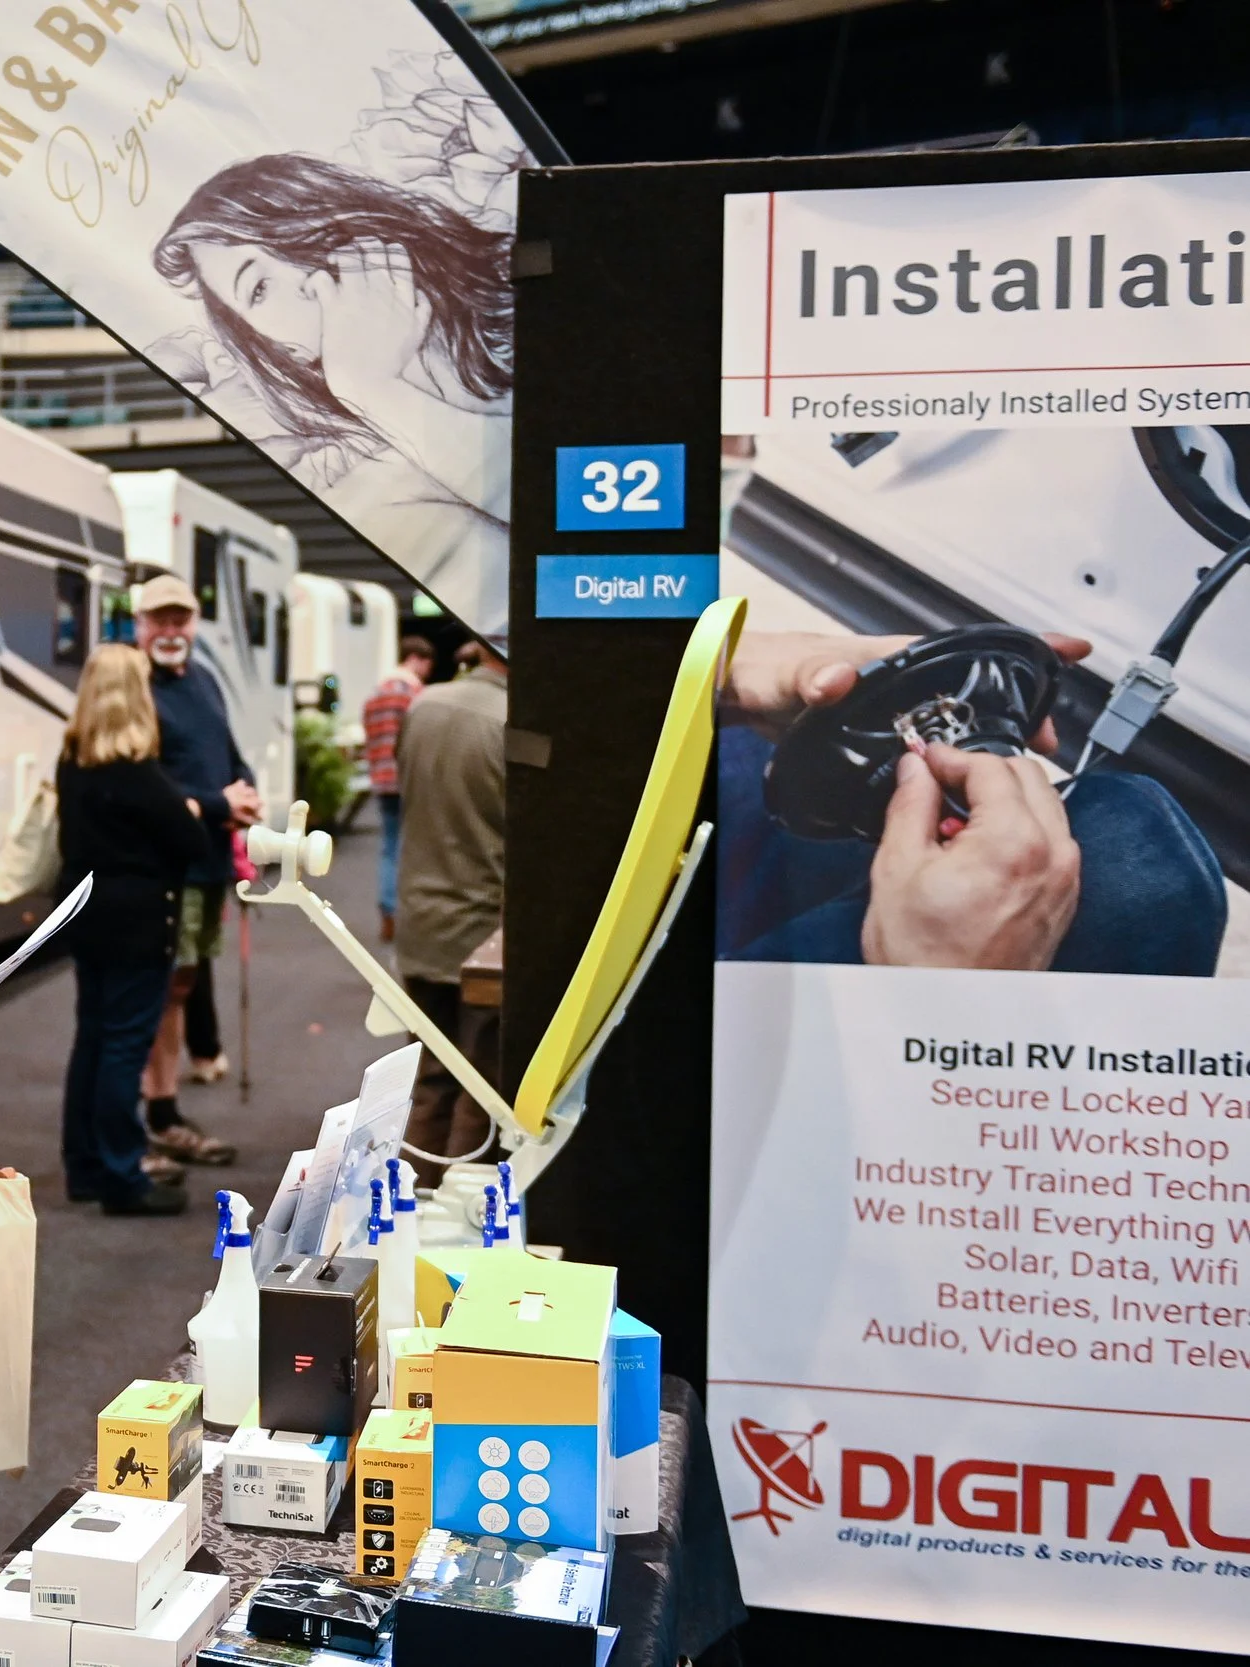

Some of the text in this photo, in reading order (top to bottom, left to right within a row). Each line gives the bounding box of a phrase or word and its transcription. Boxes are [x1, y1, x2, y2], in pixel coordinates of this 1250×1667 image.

[2, 55, 77, 113] &
[45, 2, 202, 228] Original
[799, 229, 1246, 319] Installati
[791, 390, 991, 422] Professionaly
[999, 386, 1129, 416] Installed
[581, 460, 661, 514] 32
[575, 574, 687, 605] Digital RV
[904, 1037, 1250, 1078] Digital RV Installati
[931, 1080, 1050, 1112] Secure
[1061, 1086, 1189, 1118] Locked
[979, 1122, 1230, 1167] Full Workshop
[854, 1158, 1250, 1203] Industry Trained Techn
[853, 1197, 907, 1226] We
[918, 1200, 1021, 1233] Install
[1033, 1207, 1216, 1250] Everything
[964, 1245, 1239, 1287] Solar, Data, Wifi
[937, 1283, 1100, 1324] Batteries,
[862, 1318, 968, 1355] Audio,
[978, 1326, 1078, 1359] Video
[1089, 1336, 1153, 1364] and
[636, 1361, 646, 1369] XL
[105, 1426, 149, 1439] SmartCharge
[362, 1458, 416, 1470] SmartCharge 2
[268, 1509, 314, 1522] TechniSat
[841, 1449, 1250, 1555] DIGITAL
[837, 1527, 1250, 1579] digital products & services for the
